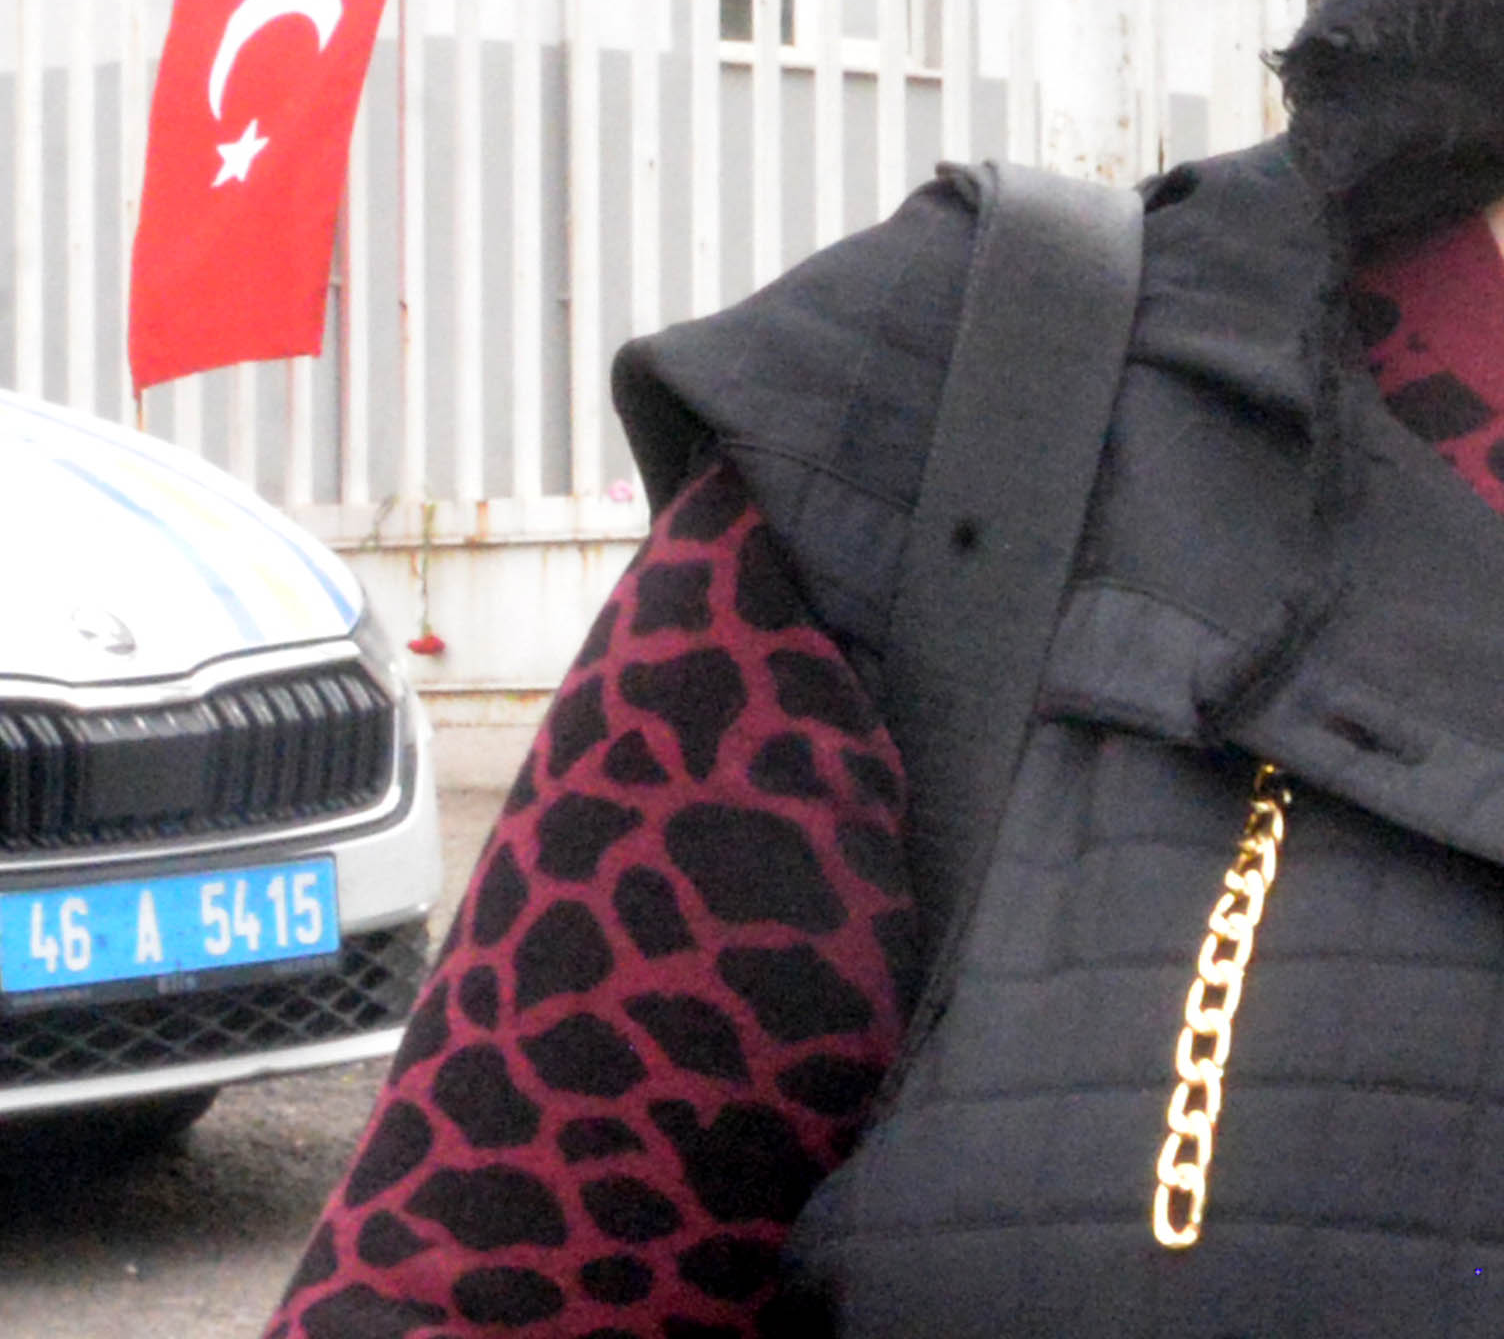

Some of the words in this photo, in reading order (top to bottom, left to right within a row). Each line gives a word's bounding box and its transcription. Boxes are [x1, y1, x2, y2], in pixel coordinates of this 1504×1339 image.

[29, 896, 92, 973] 46
[135, 889, 164, 964] A
[199, 873, 323, 956] 5415
